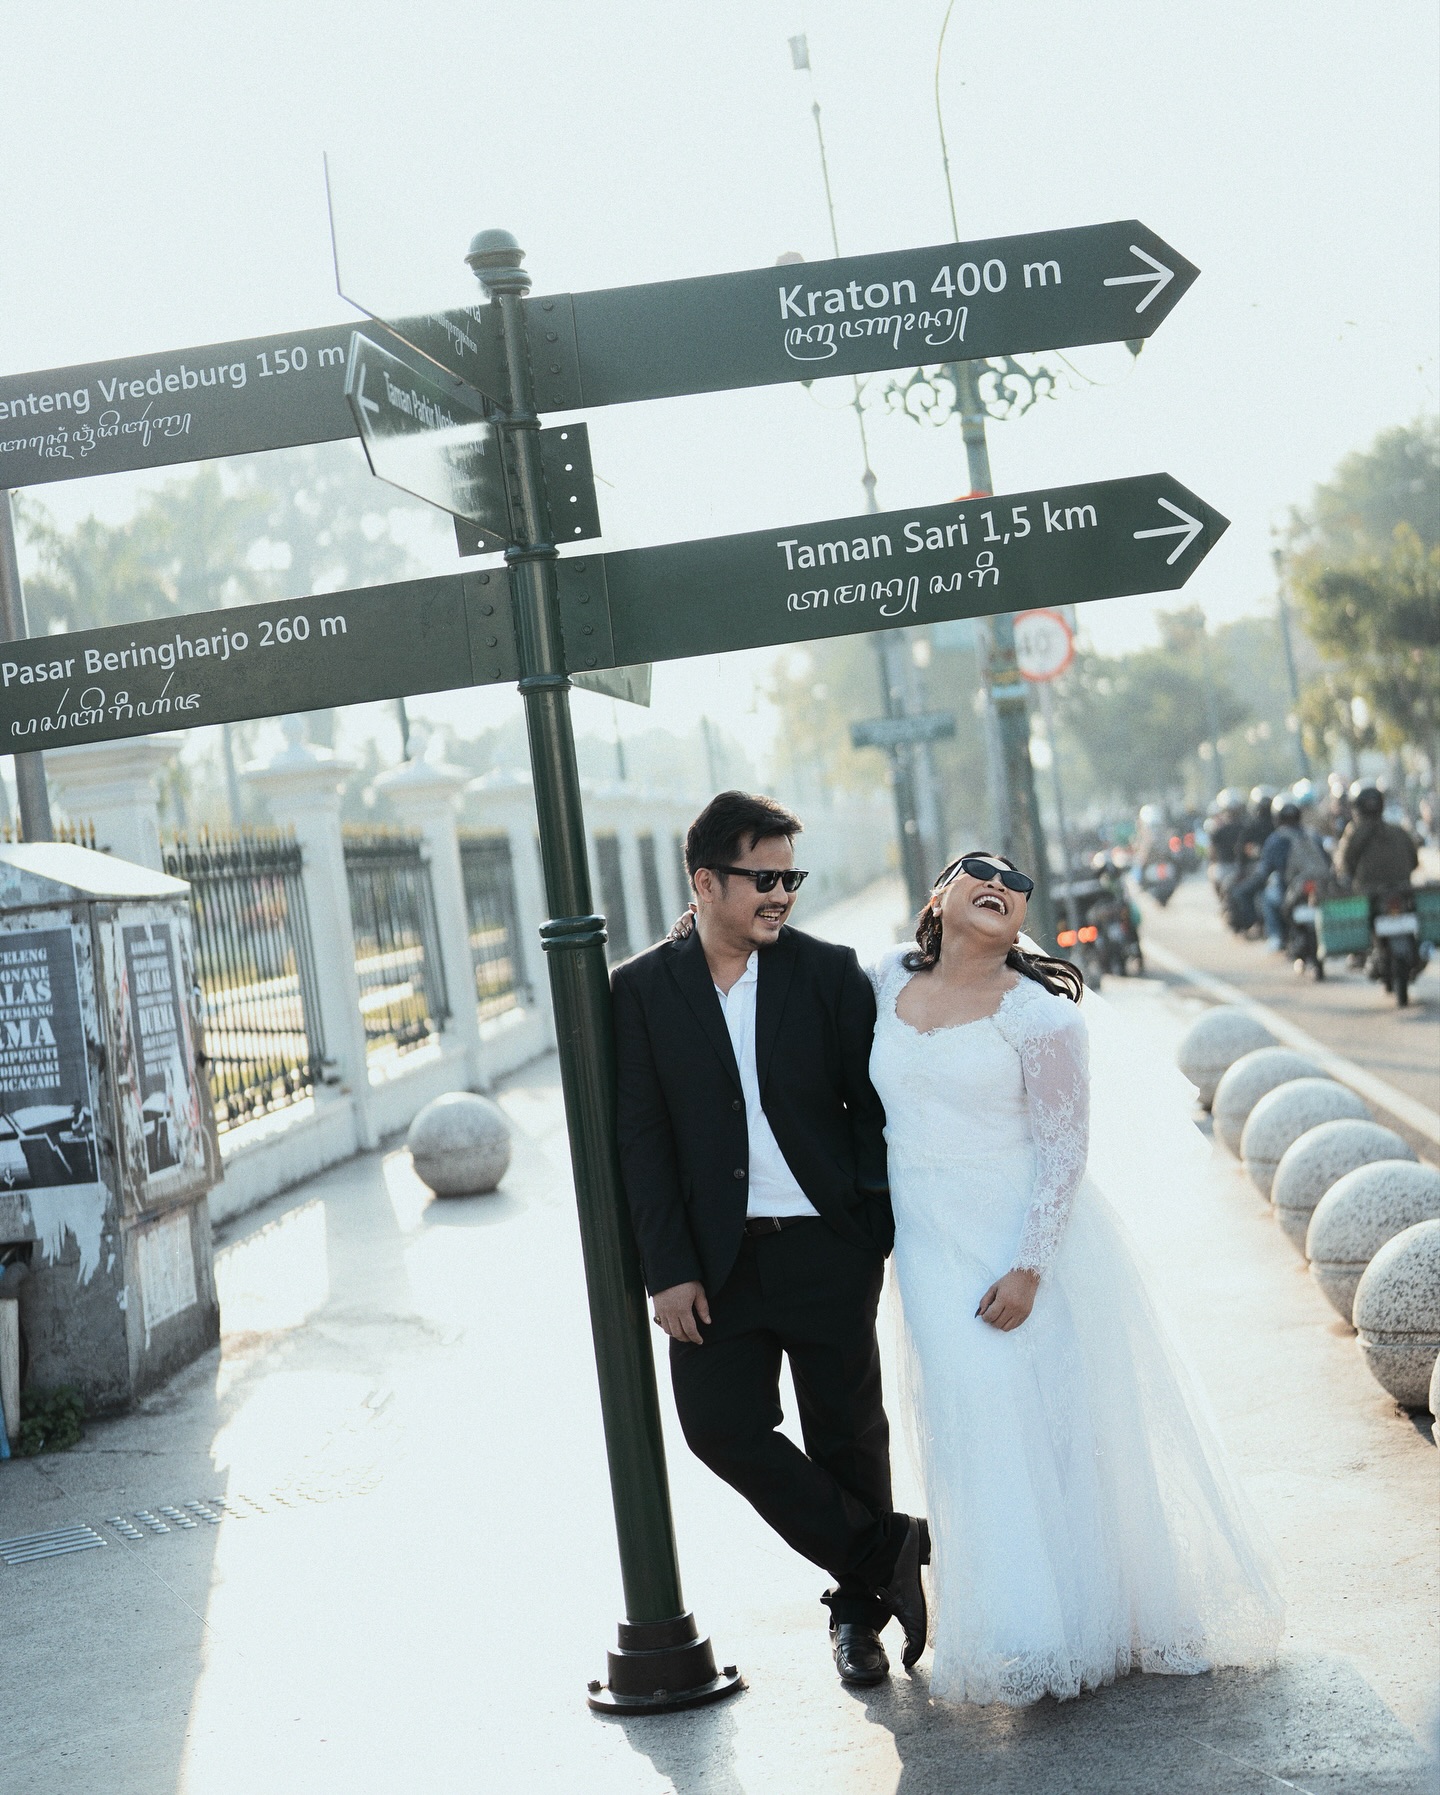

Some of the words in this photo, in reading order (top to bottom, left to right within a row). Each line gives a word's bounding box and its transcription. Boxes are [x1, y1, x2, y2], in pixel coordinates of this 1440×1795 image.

[778, 279, 917, 320] Kraton
[930, 258, 1008, 299] 400
[1022, 259, 1063, 289] m
[97, 361, 247, 402] Vredeburg
[256, 345, 308, 377] 150
[318, 344, 345, 368] m
[383, 370, 413, 415] Taman
[777, 533, 893, 571] Taman
[903, 513, 969, 554] Sari
[980, 505, 1032, 545] 1,5
[1043, 500, 1098, 534] km
[1, 656, 76, 687] Pasar
[84, 627, 249, 675] Beringharjo
[258, 615, 310, 647] 260
[319, 614, 347, 637] m
[0, 1017, 57, 1050] MA
